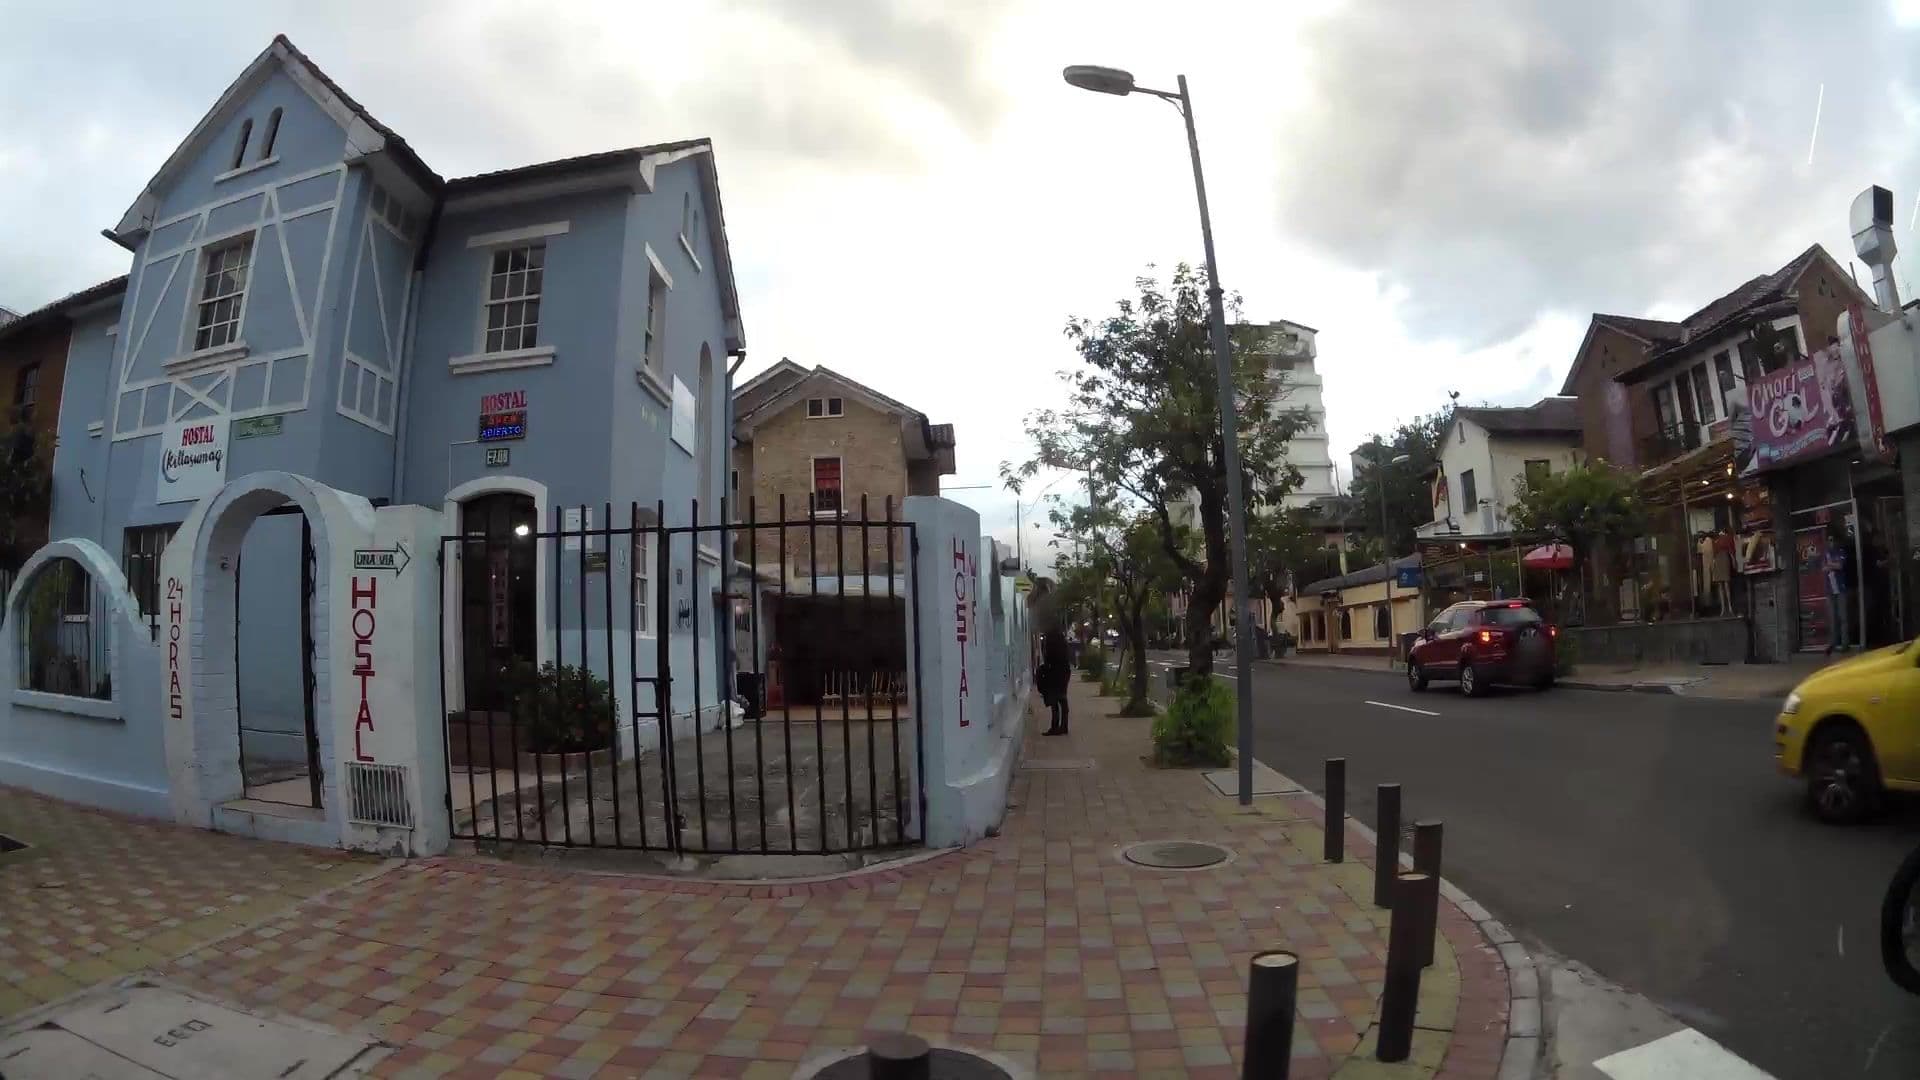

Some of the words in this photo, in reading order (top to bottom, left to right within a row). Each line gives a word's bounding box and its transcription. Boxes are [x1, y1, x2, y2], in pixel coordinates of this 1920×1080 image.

[481, 390, 527, 415] HOSTAL
[182, 425, 215, 446] HOSTAL
[356, 554, 375, 566] UNA
[378, 553, 395, 566] VIA
[167, 577, 183, 600] 24
[953, 536, 969, 727] HOSTAL
[169, 603, 182, 719] HORAS
[352, 577, 376, 762] HOSTAL
